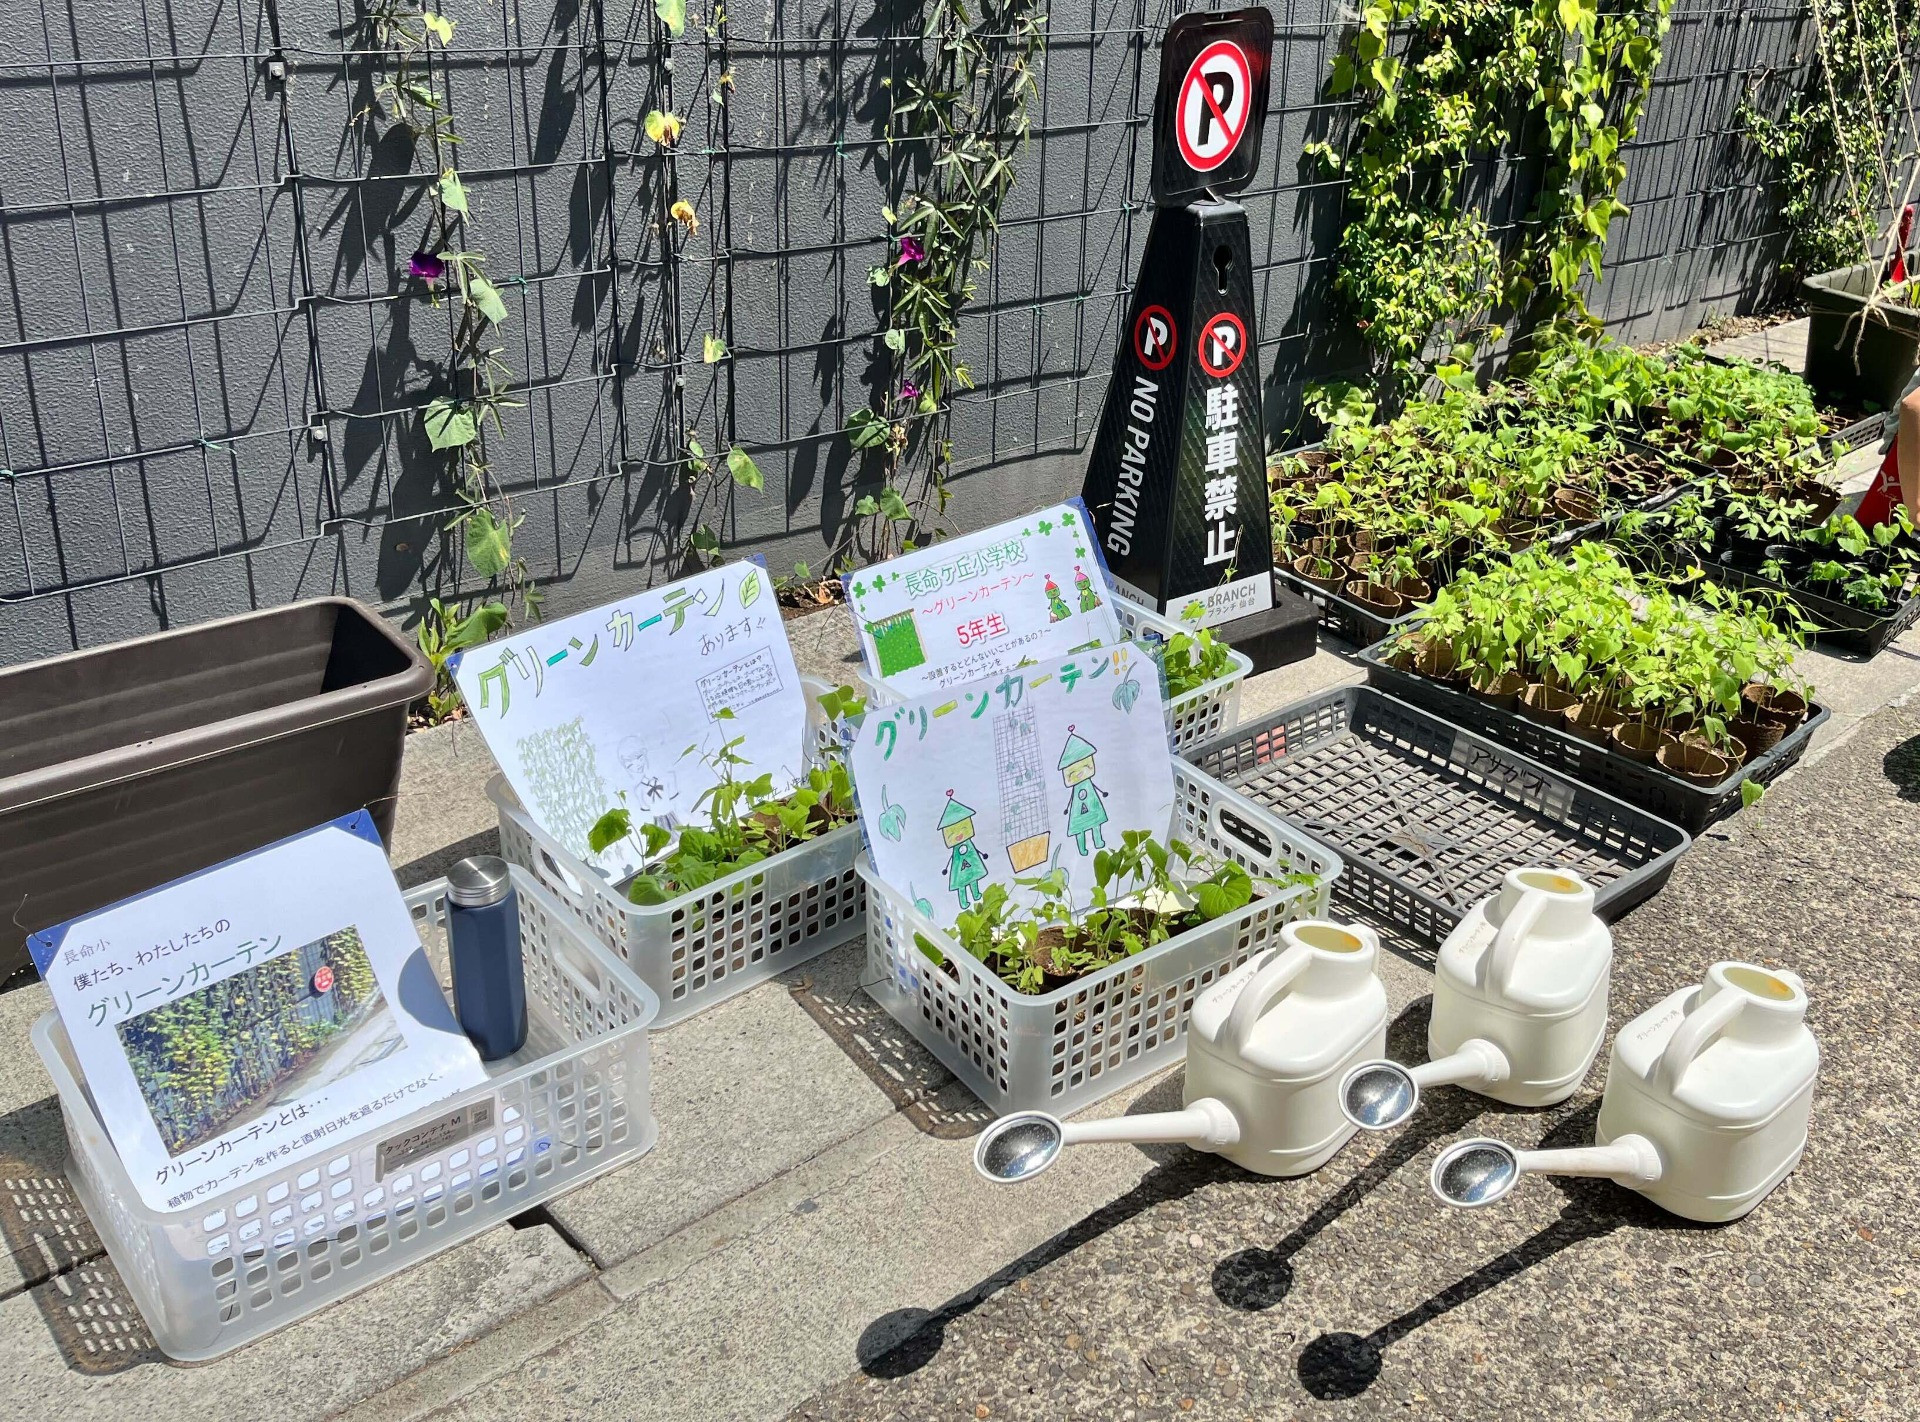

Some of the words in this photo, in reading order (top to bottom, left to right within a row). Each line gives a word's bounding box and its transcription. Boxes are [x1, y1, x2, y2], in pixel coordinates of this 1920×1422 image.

[1130, 375, 1159, 424] NO
[1107, 424, 1150, 556] PARKING
[1203, 383, 1239, 566] 駐車禁止
[1207, 583, 1257, 609] BRANCH
[1208, 603, 1237, 618] ブランチ
[477, 578, 726, 720] グリーンカーテン
[956, 612, 1007, 646] 5年生
[1470, 744, 1552, 797] アサガオ
[63, 938, 112, 966] 長命小
[73, 918, 231, 992] 僕たち、わたしたちの
[88, 935, 281, 1027] グリーンカーテン
[451, 1115, 461, 1127] M
